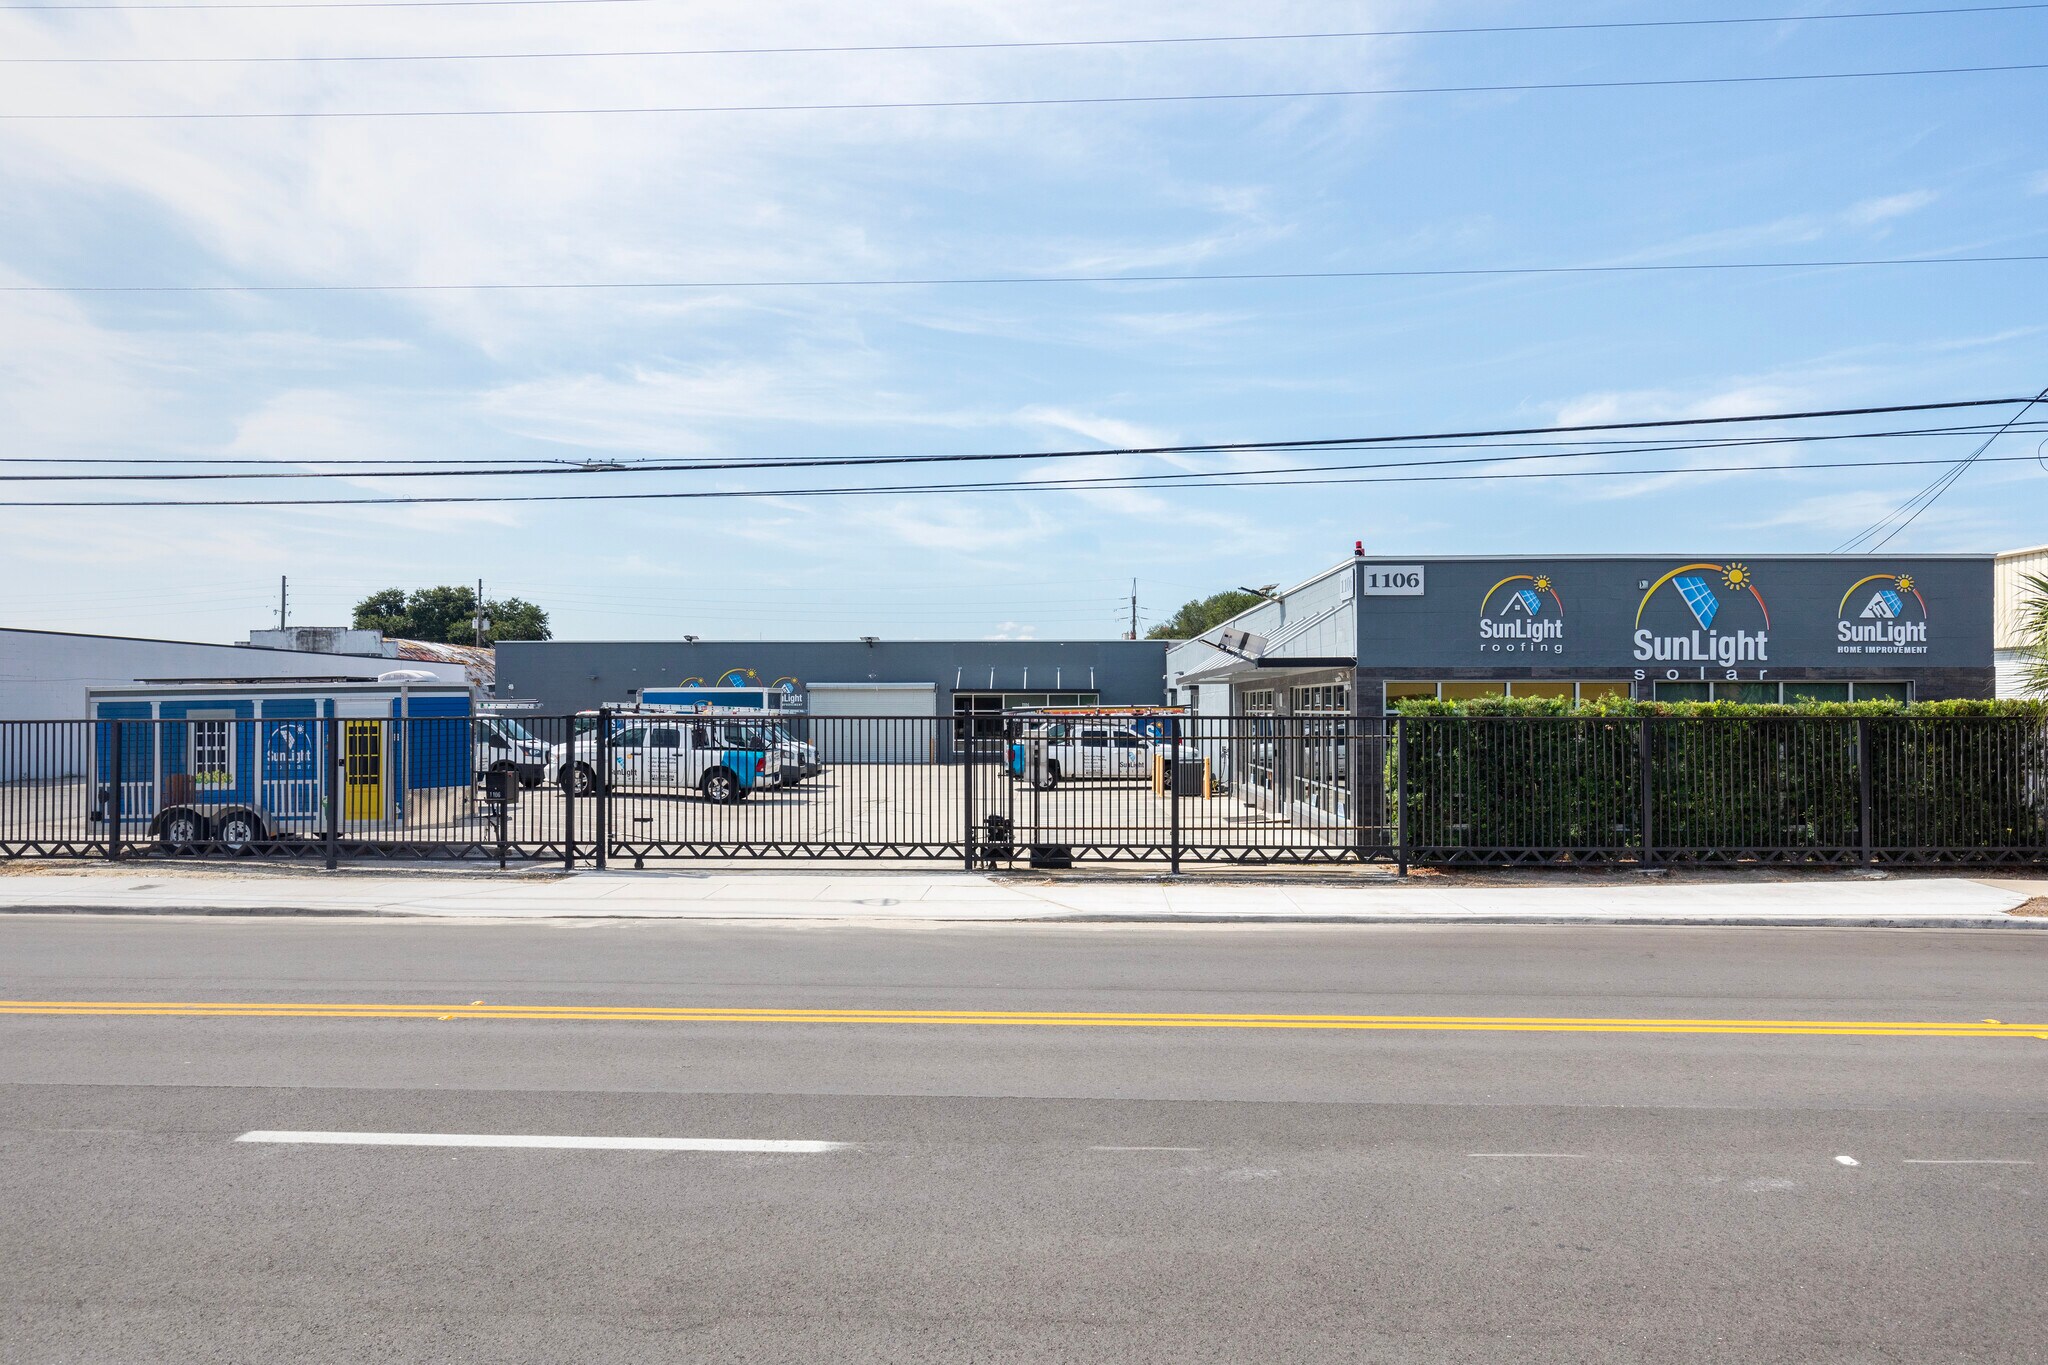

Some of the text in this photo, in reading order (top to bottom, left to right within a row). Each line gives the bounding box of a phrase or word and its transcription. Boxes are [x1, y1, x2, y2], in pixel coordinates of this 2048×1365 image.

[1369, 573, 1420, 588] 1106
[1480, 619, 1563, 642] SunLight
[1837, 621, 1927, 646] SunLight
[1480, 643, 1563, 654] roofing
[1633, 629, 1768, 667] SunLight
[1837, 646, 1928, 654] HOME IMPROVEMENT
[1634, 667, 1768, 680] solar
